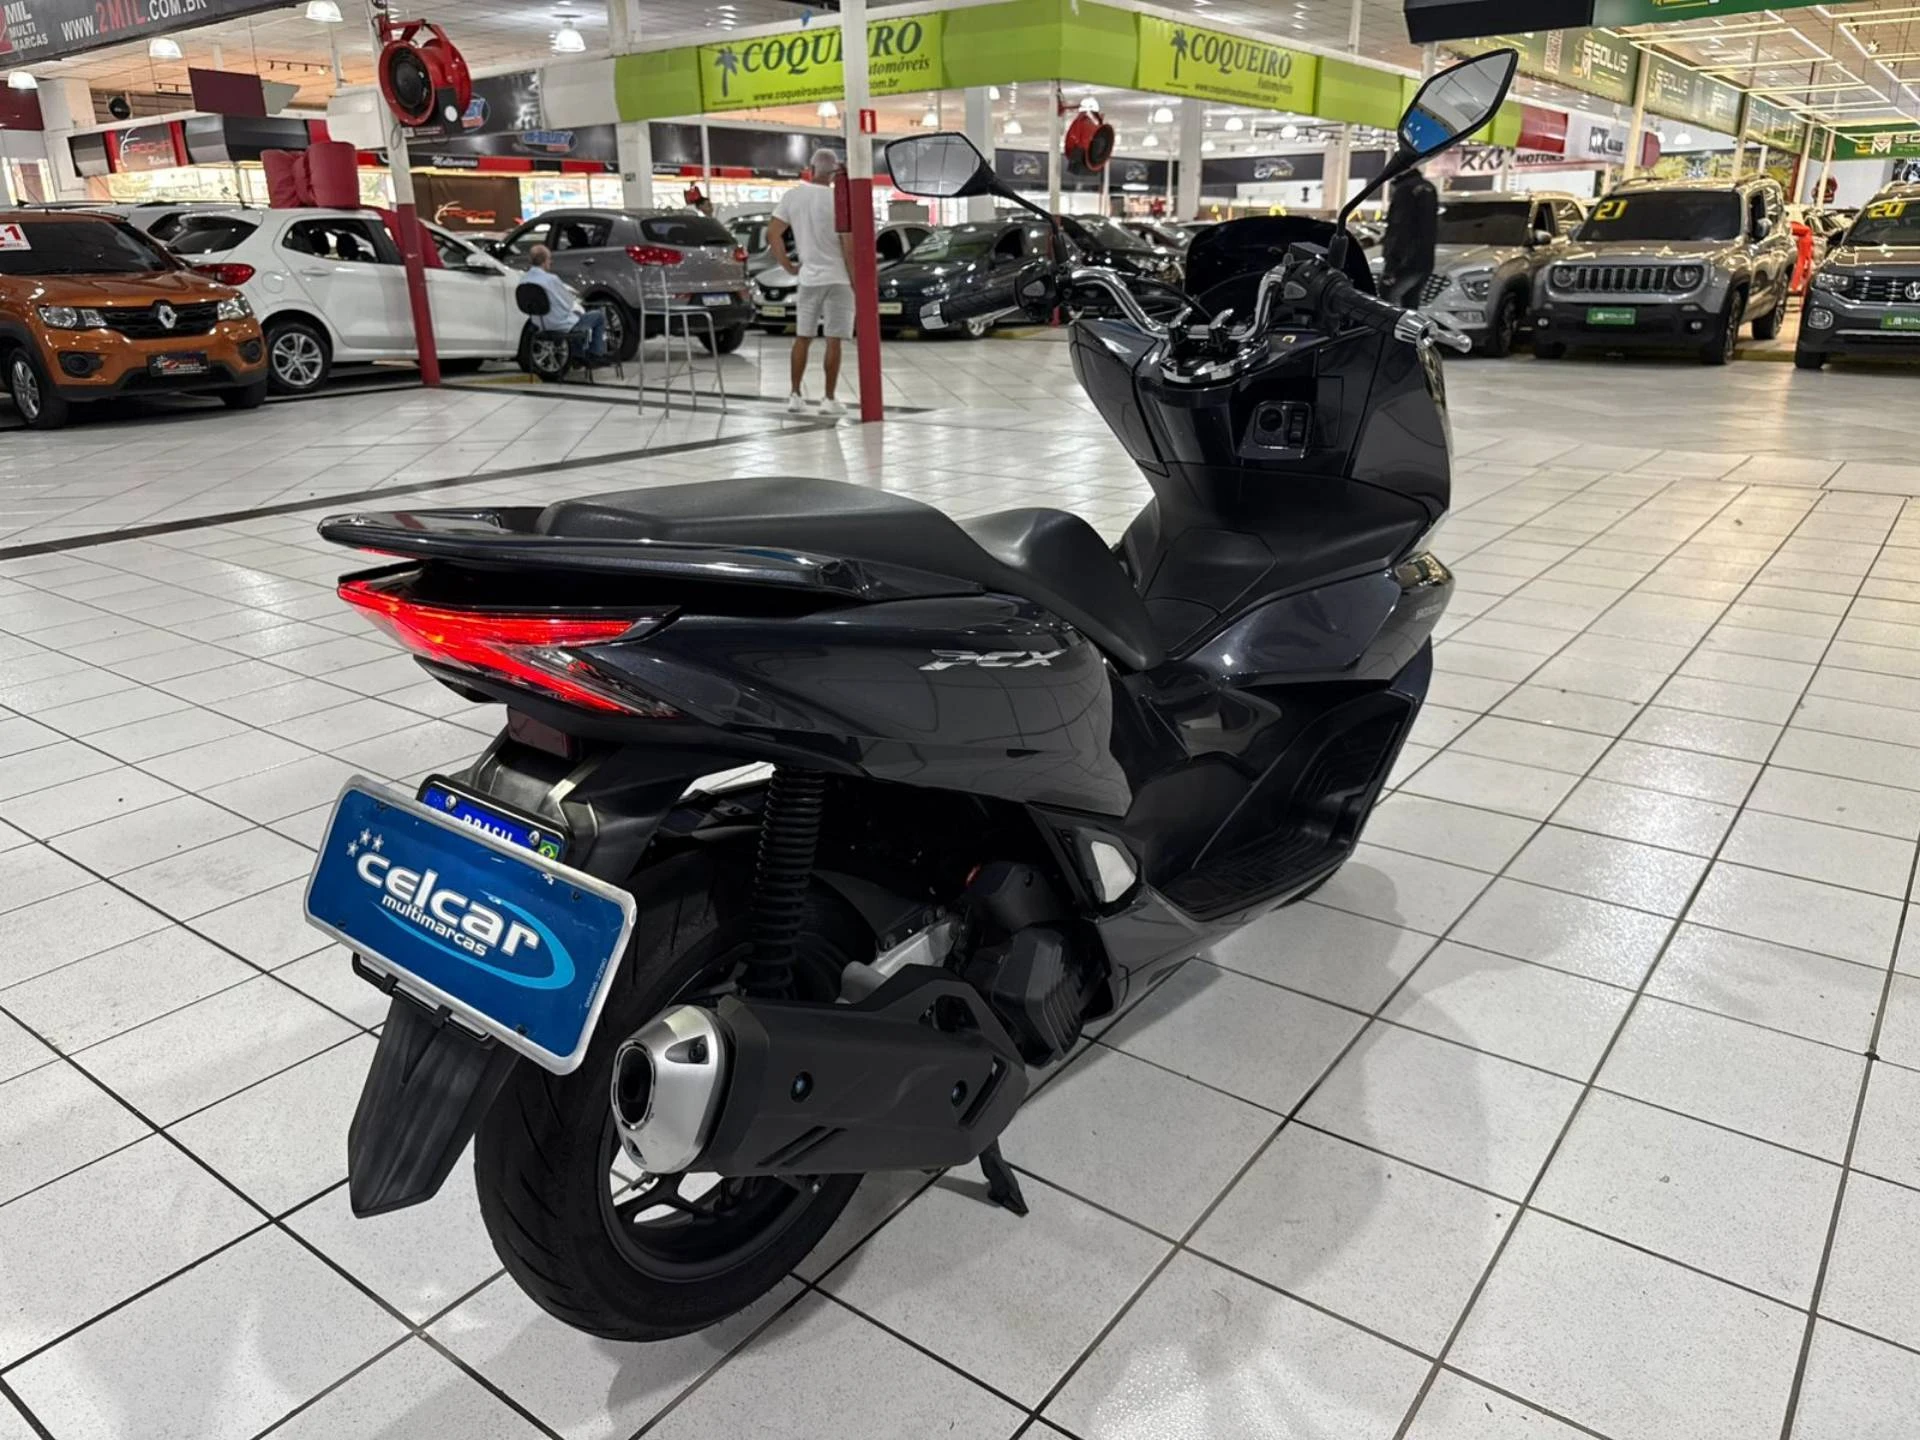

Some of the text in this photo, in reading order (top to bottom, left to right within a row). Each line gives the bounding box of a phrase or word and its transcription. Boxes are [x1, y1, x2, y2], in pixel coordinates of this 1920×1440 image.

[9, 22, 36, 38] MULTI
[12, 33, 49, 51] MARCAS
[869, 54, 930, 76] tomóveis
[1190, 33, 1292, 79] COQUEIRO
[1591, 42, 1629, 75] SOLUS
[1593, 199, 1629, 221] 21
[1868, 201, 1907, 219] 20
[918, 649, 1068, 671] PCX
[356, 852, 540, 956] celcar
[381, 893, 489, 958] multimarcas
